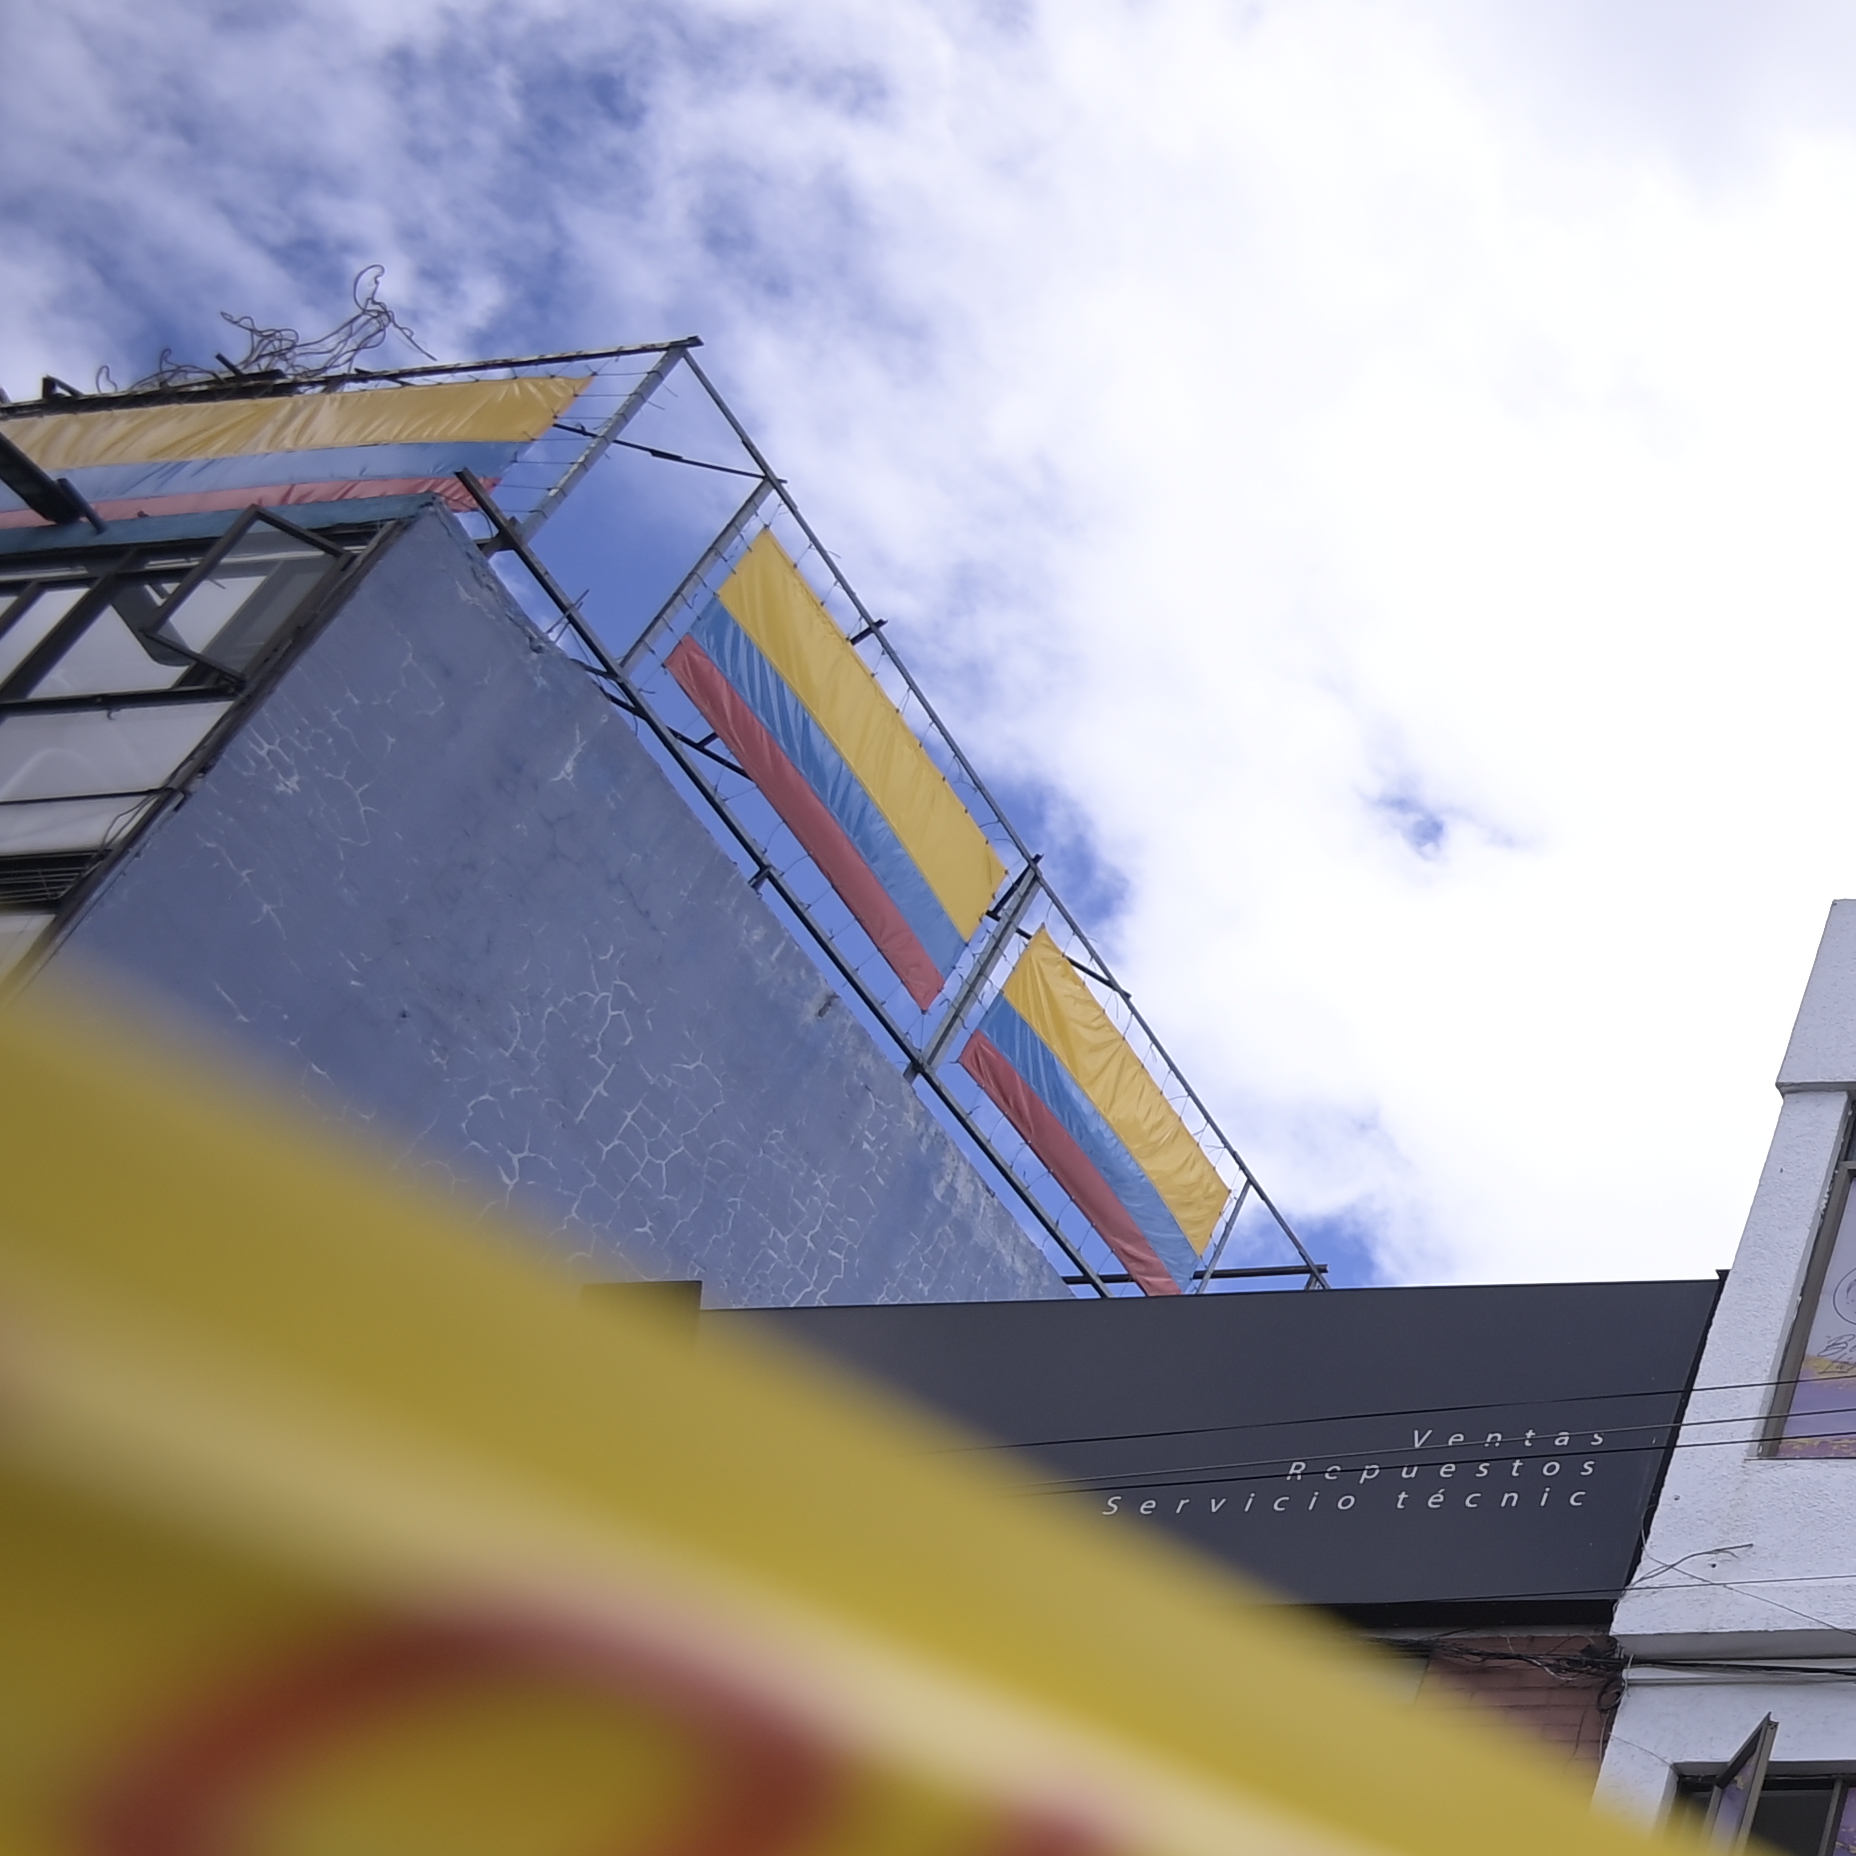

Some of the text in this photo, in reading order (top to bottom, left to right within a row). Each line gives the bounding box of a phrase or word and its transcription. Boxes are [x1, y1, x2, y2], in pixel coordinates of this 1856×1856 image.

[1411, 1427, 1605, 1450] Ventas
[1286, 1458, 1596, 1484] Repuestos
[1101, 1490, 1356, 1516] Servicio
